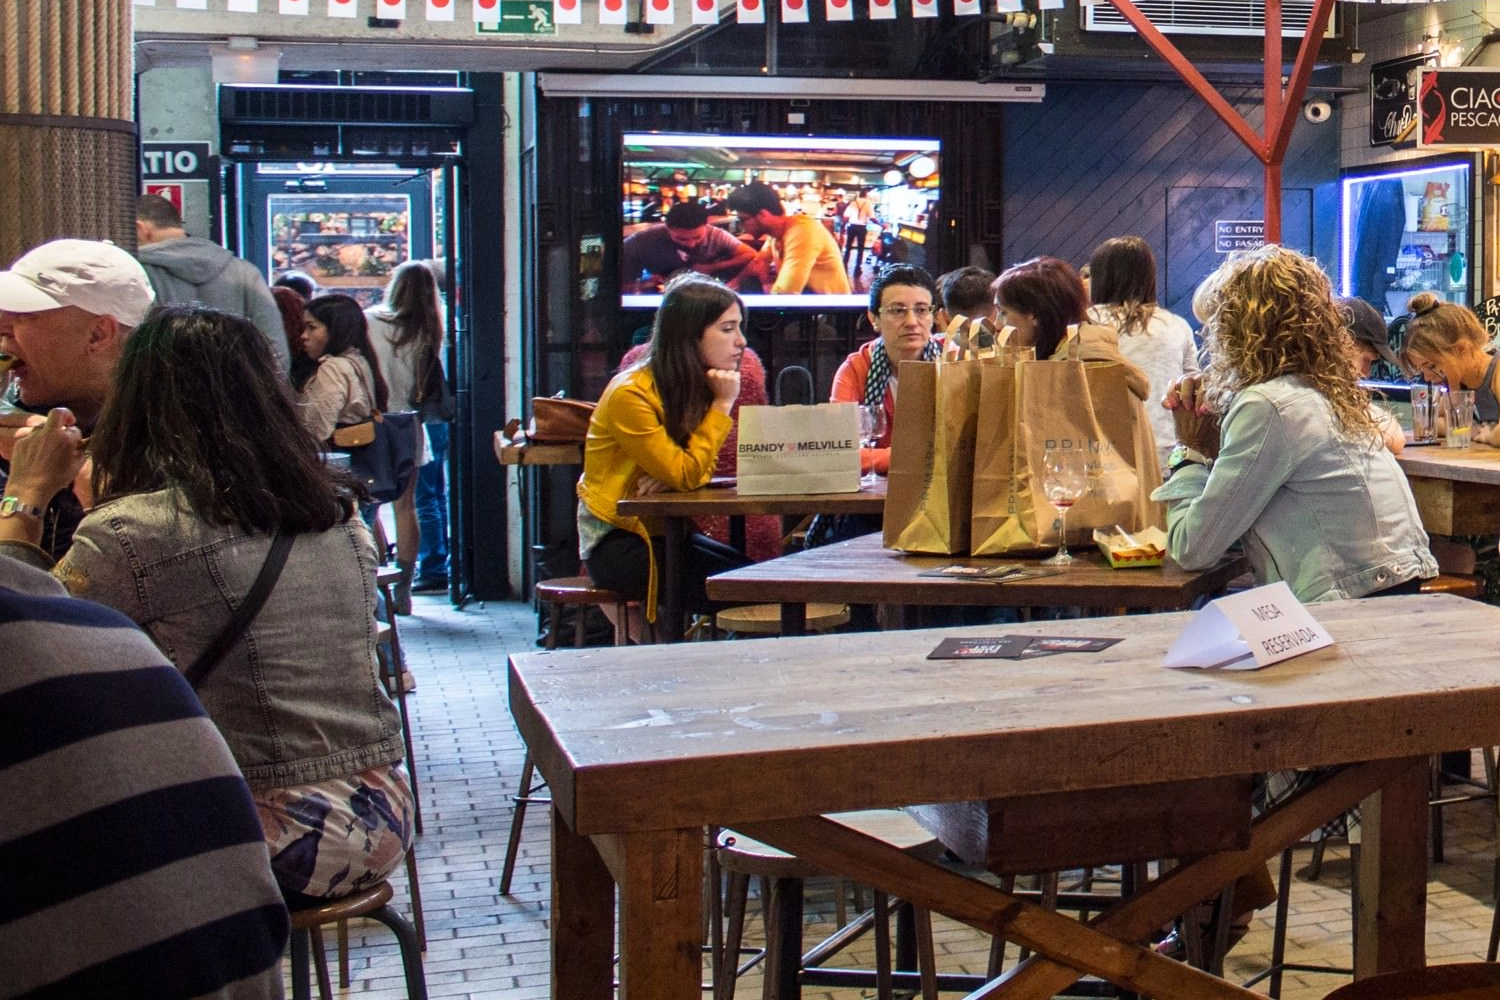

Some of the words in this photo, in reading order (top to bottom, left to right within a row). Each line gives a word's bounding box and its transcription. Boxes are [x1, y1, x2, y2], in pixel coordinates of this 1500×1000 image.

[1218, 226, 1233, 234] NO
[1235, 226, 1264, 234] ENTRY
[1218, 240, 1233, 248] NO
[739, 443, 785, 454] BRANDY
[797, 439, 853, 451] MELVILLE
[1251, 603, 1285, 623] MESA
[1261, 626, 1320, 656] RESERVADA
